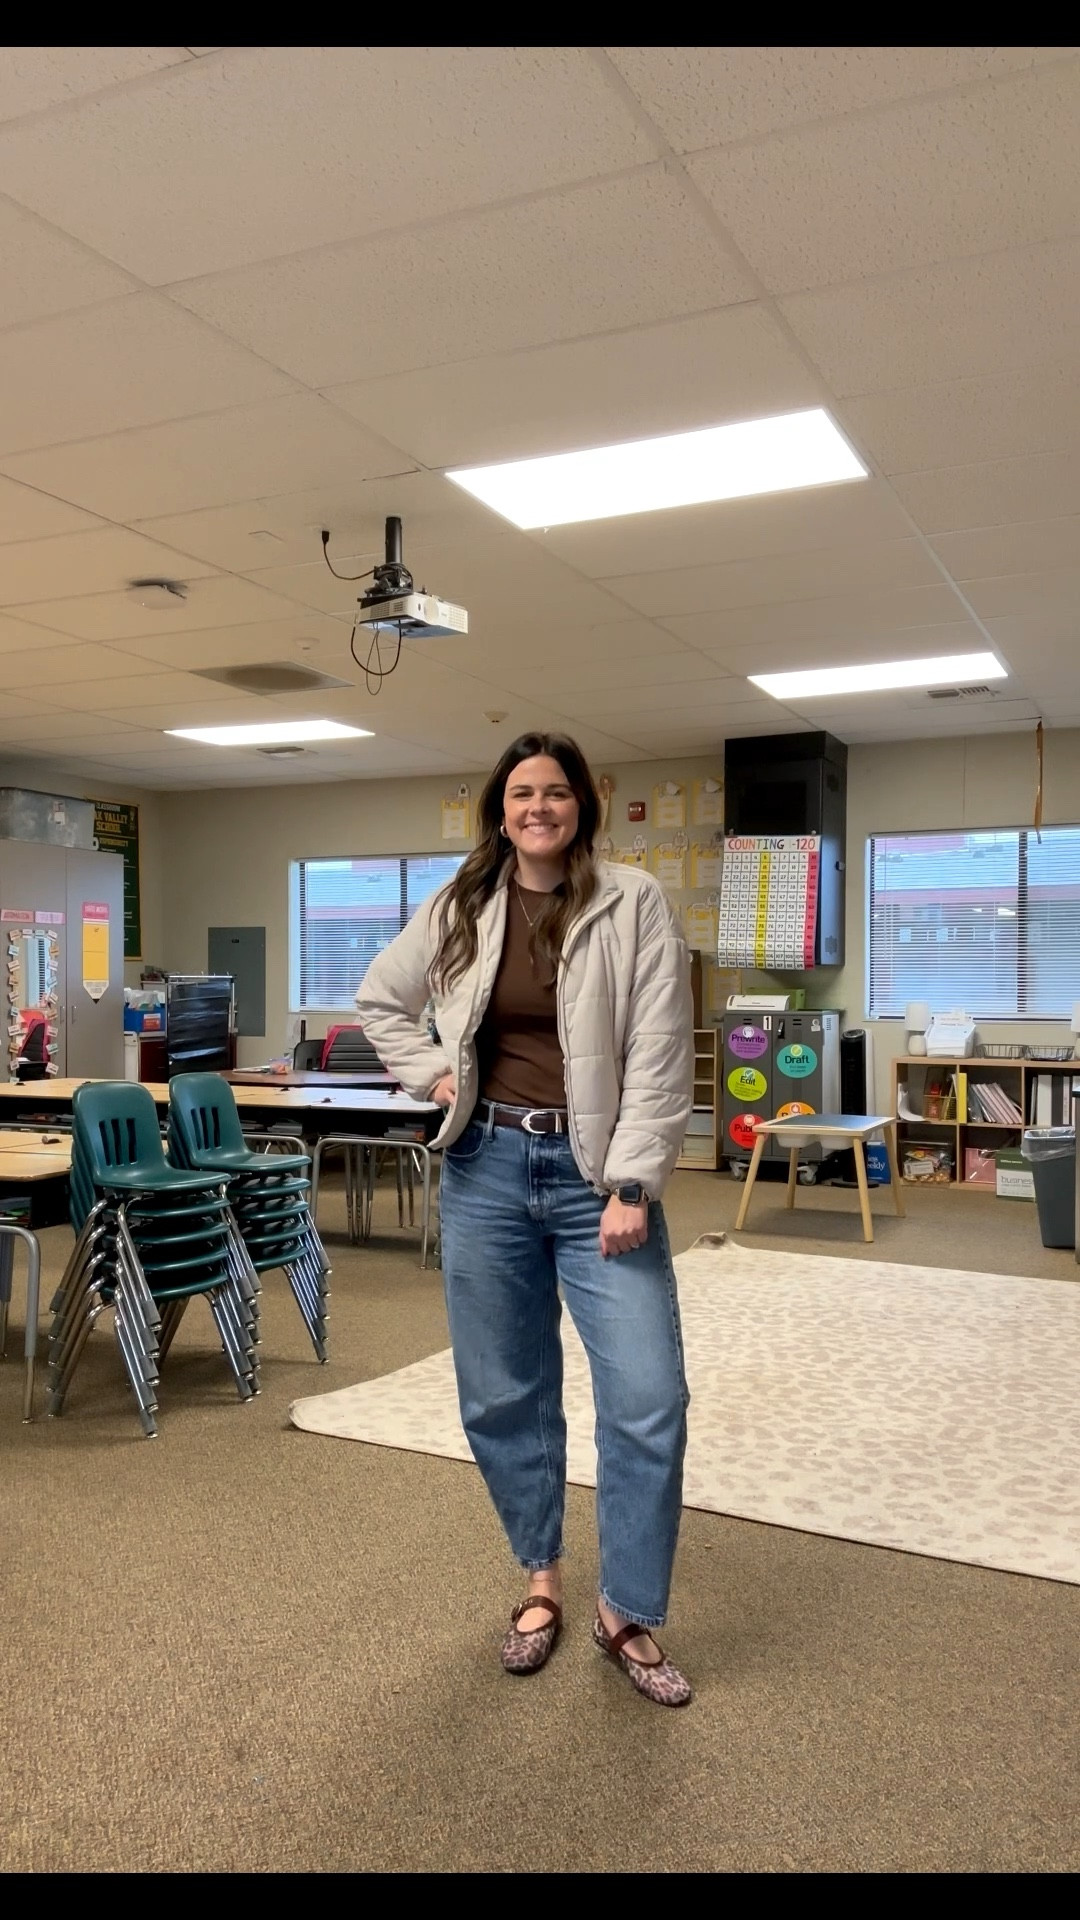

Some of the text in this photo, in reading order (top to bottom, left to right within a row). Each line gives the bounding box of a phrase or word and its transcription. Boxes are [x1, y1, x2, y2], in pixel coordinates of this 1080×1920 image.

[104, 811, 128, 825] VALLEY
[96, 820, 122, 833] SCHOOL
[728, 838, 785, 850] COUNTING
[765, 1016, 770, 1030] 1
[731, 1033, 766, 1043] Prewrite
[784, 1055, 810, 1064] Draft
[740, 1075, 756, 1086] Edit
[734, 1124, 753, 1133] Publ
[867, 1161, 886, 1171] eekly
[1000, 1175, 1033, 1185] busines
